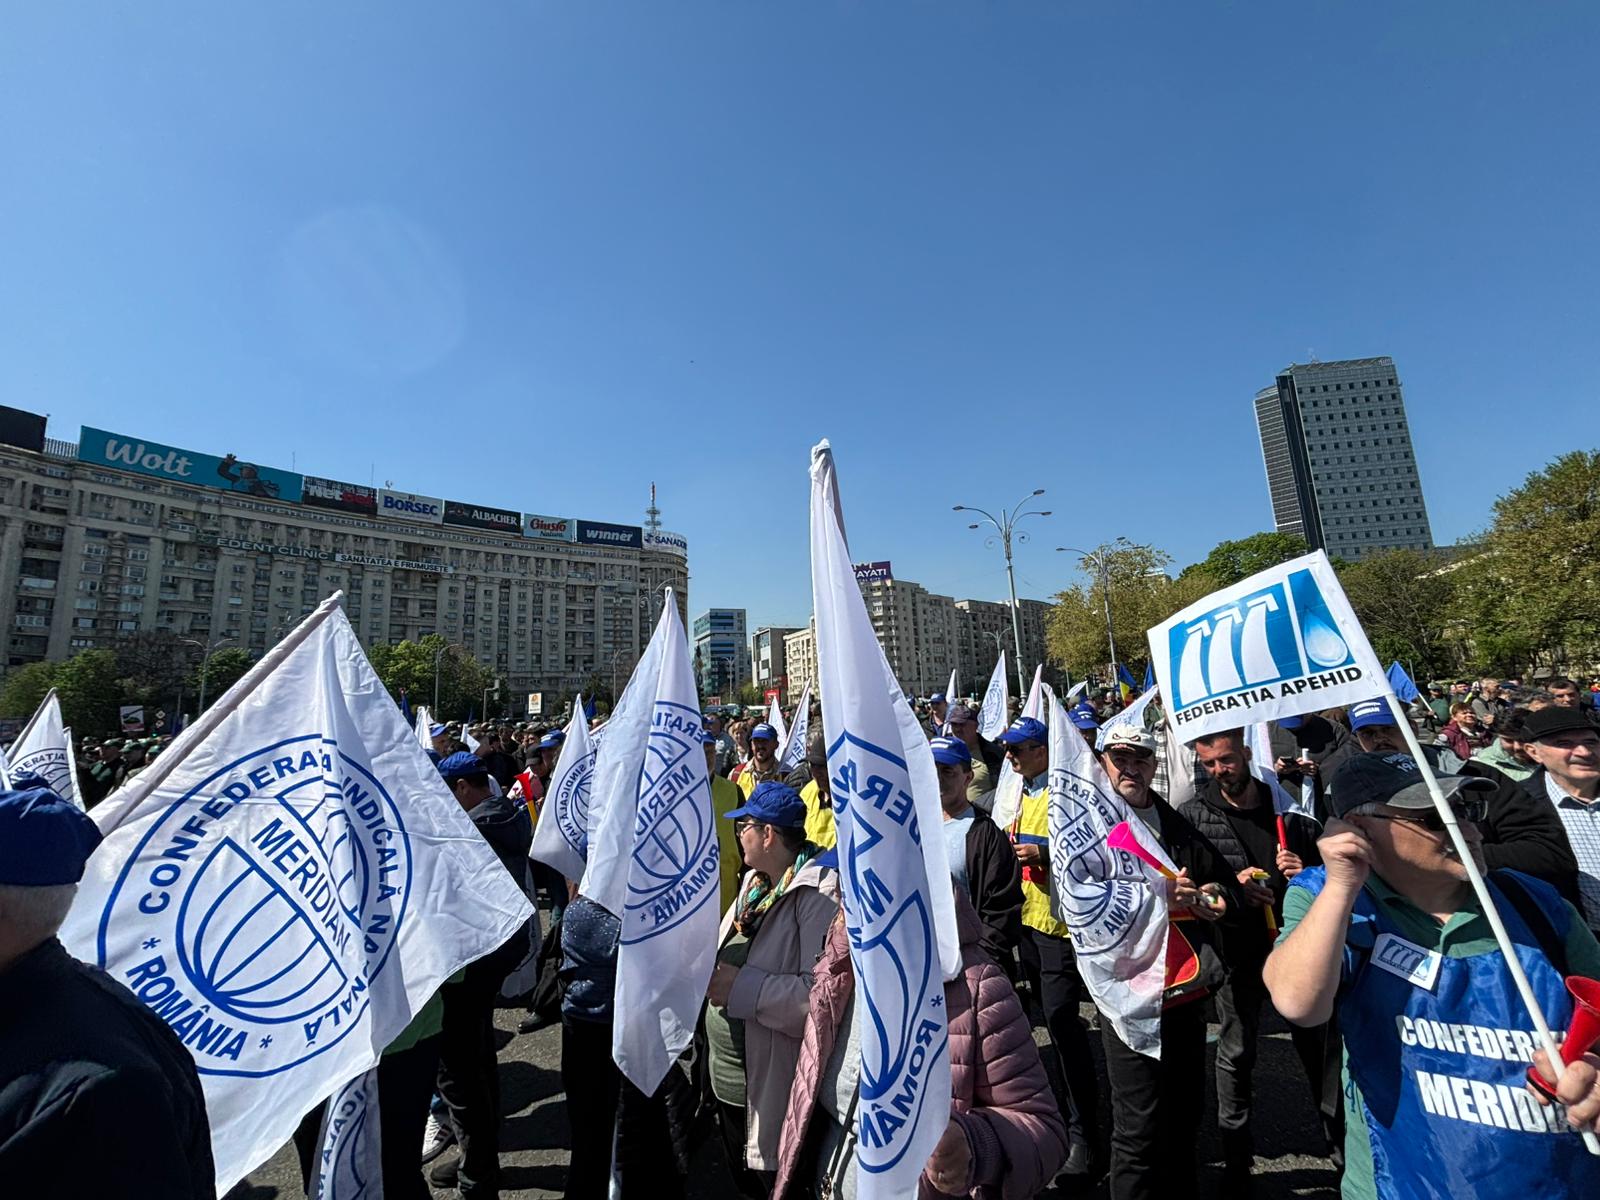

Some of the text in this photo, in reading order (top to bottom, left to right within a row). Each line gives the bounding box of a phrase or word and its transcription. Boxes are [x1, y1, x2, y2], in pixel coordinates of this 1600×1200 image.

[106, 439, 193, 476] Wolt
[383, 495, 438, 515] BORSEC
[472, 510, 518, 525] ALBACHER
[530, 518, 567, 532] Giusto
[586, 529, 632, 541] winner
[217, 538, 329, 560] EDENT CLINIC
[857, 569, 887, 578] AYATI
[1281, 667, 1362, 696] APEHID
[251, 817, 351, 957] MERIDIAN
[125, 955, 248, 1061] ROMÂNIA
